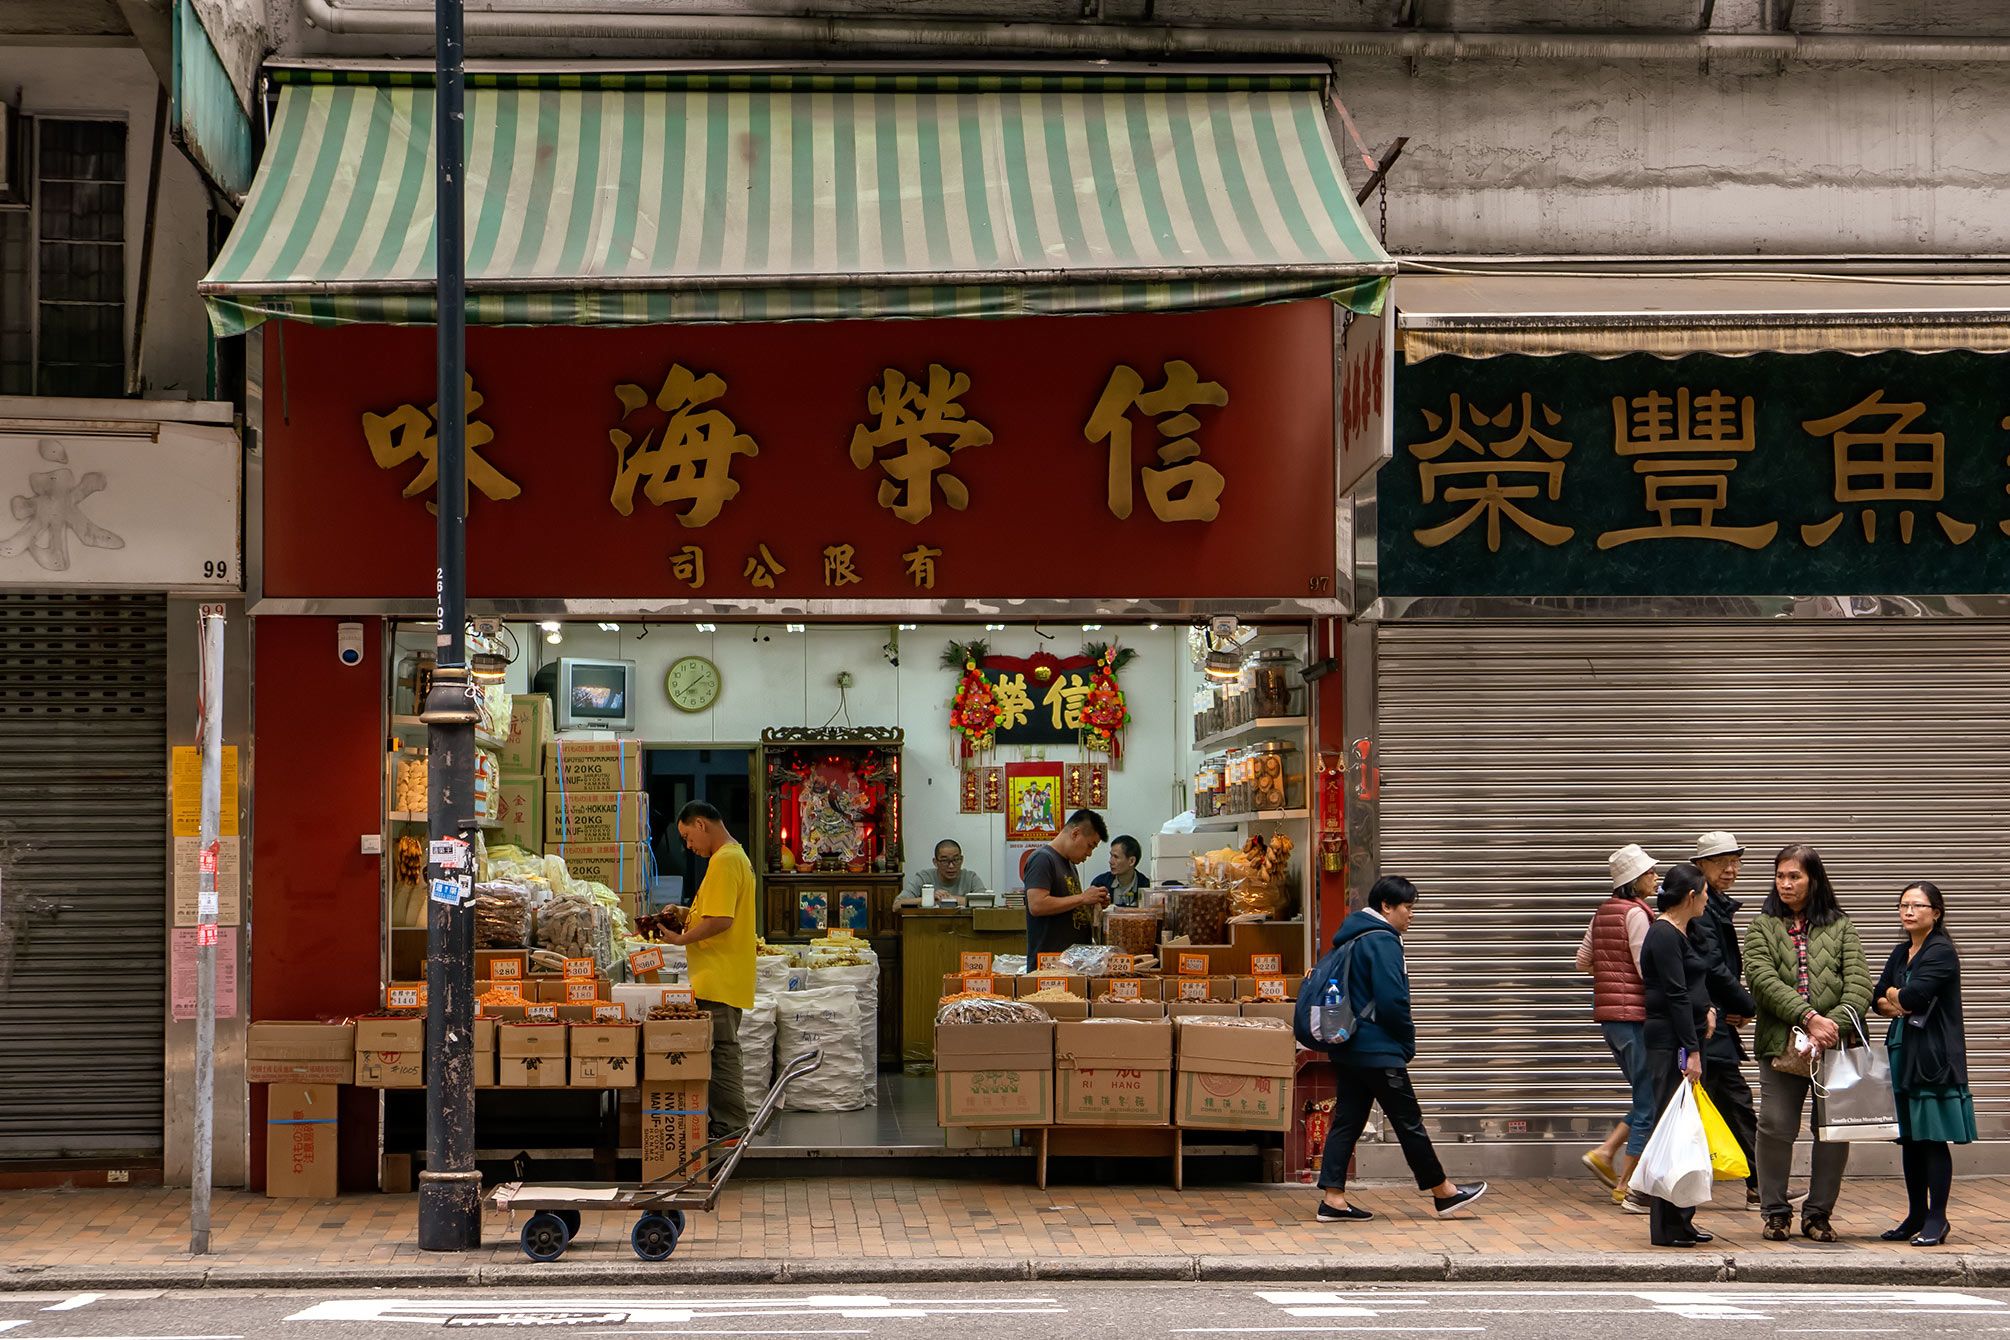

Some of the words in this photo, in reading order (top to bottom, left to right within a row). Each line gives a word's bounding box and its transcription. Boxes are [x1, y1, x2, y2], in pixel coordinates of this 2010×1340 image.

[1407, 387, 2010, 553] 榮豐魚
[203, 560, 228, 579] 99
[1308, 575, 1330, 592] 97
[202, 604, 224, 617] 99
[574, 765, 602, 773] 20KG
[574, 816, 602, 824] 20KG
[572, 866, 601, 875] 20KG
[584, 1068, 595, 1076] LL
[1082, 1080, 1093, 1088] RI
[1111, 1081, 1141, 1089] HANG
[664, 1117, 676, 1151] 20KG
